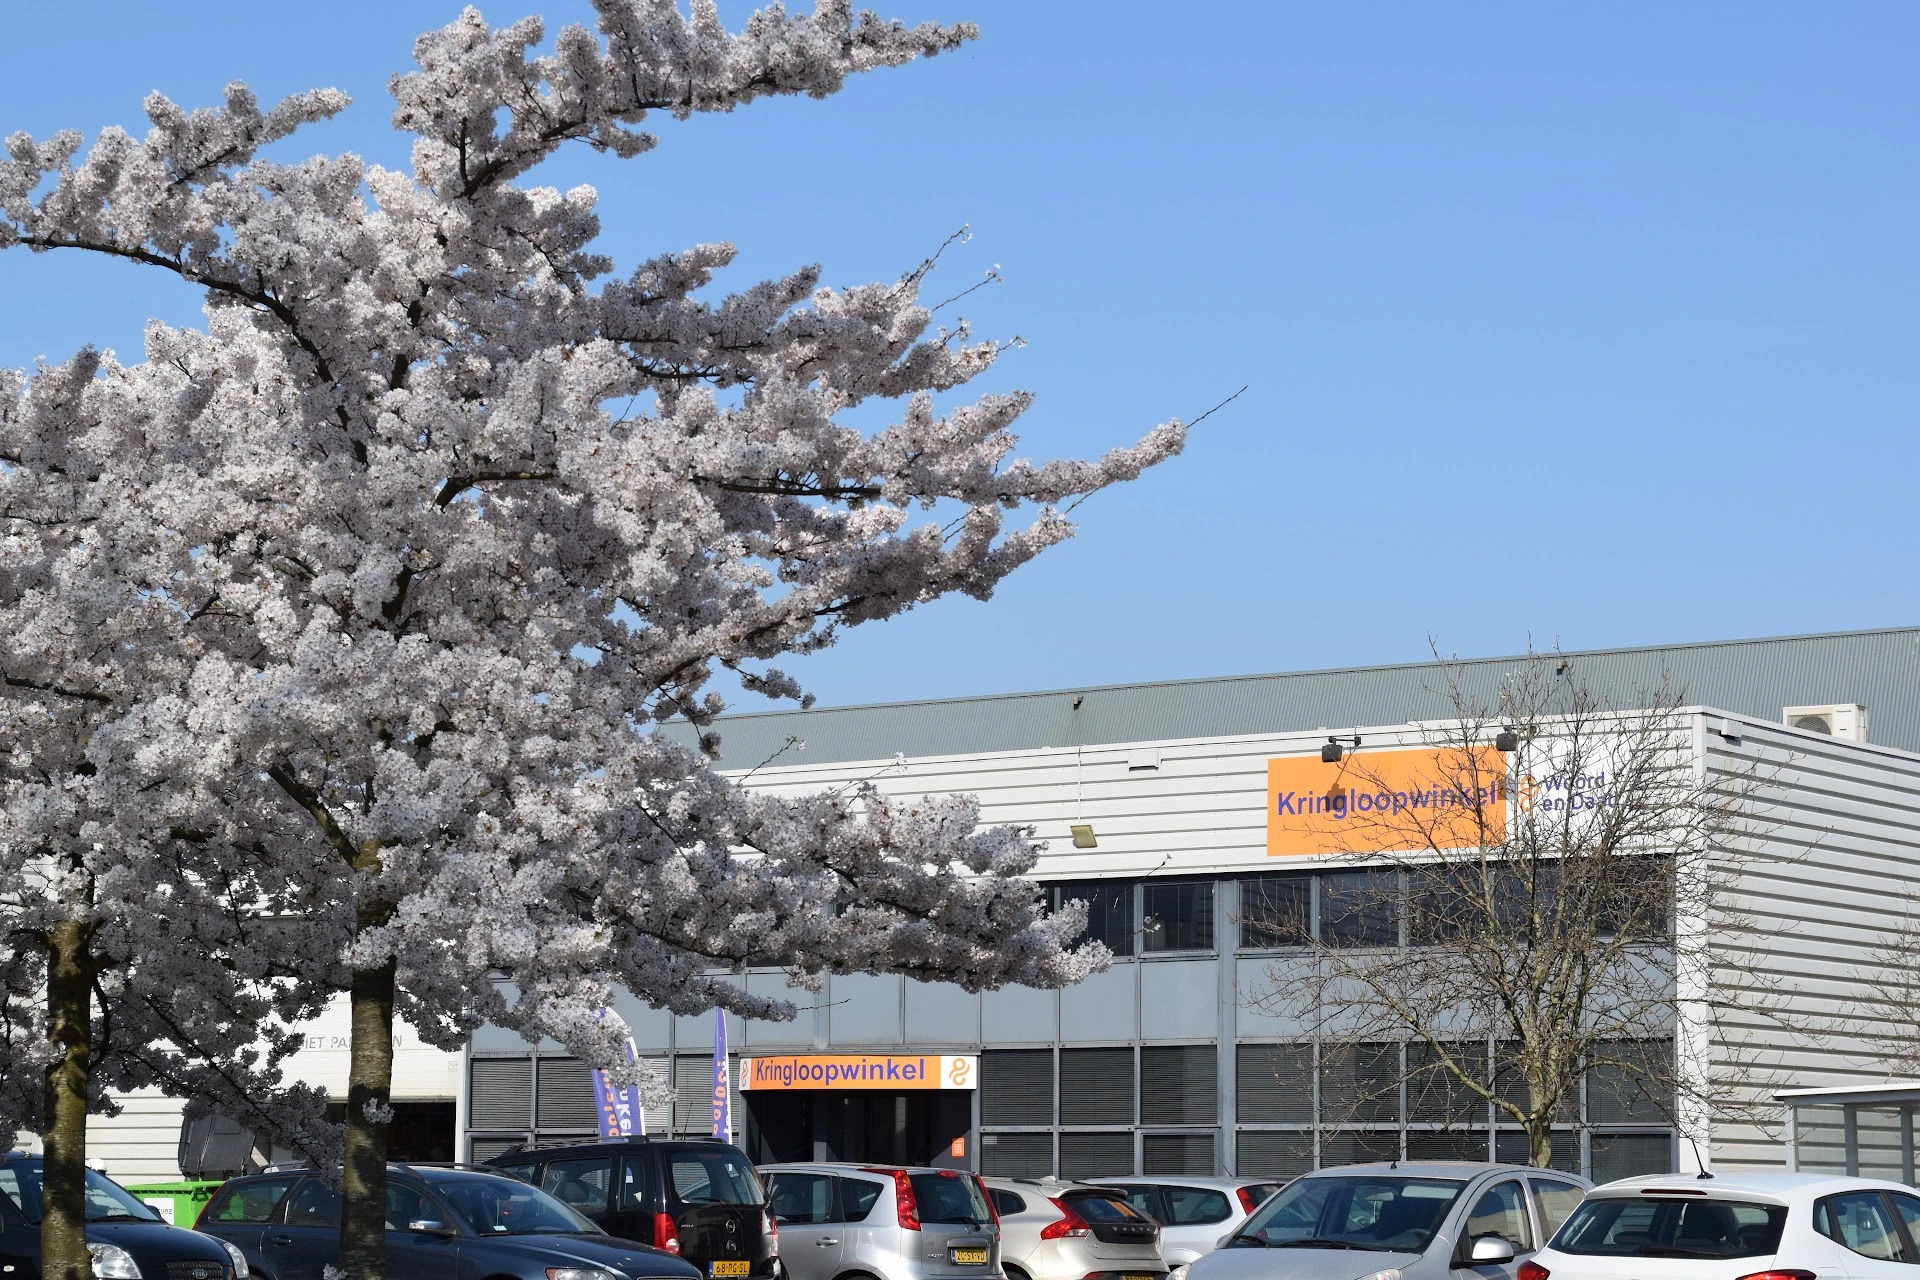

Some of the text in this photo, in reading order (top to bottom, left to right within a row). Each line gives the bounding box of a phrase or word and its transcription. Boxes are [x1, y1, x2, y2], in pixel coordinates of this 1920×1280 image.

[1278, 781, 1496, 820] Kringloopwinkel
[1543, 797, 1565, 811] en
[301, 1037, 325, 1049] IET
[756, 1058, 925, 1087] Kringloopwinkel
[716, 1263, 747, 1273] 68-PG-SL
